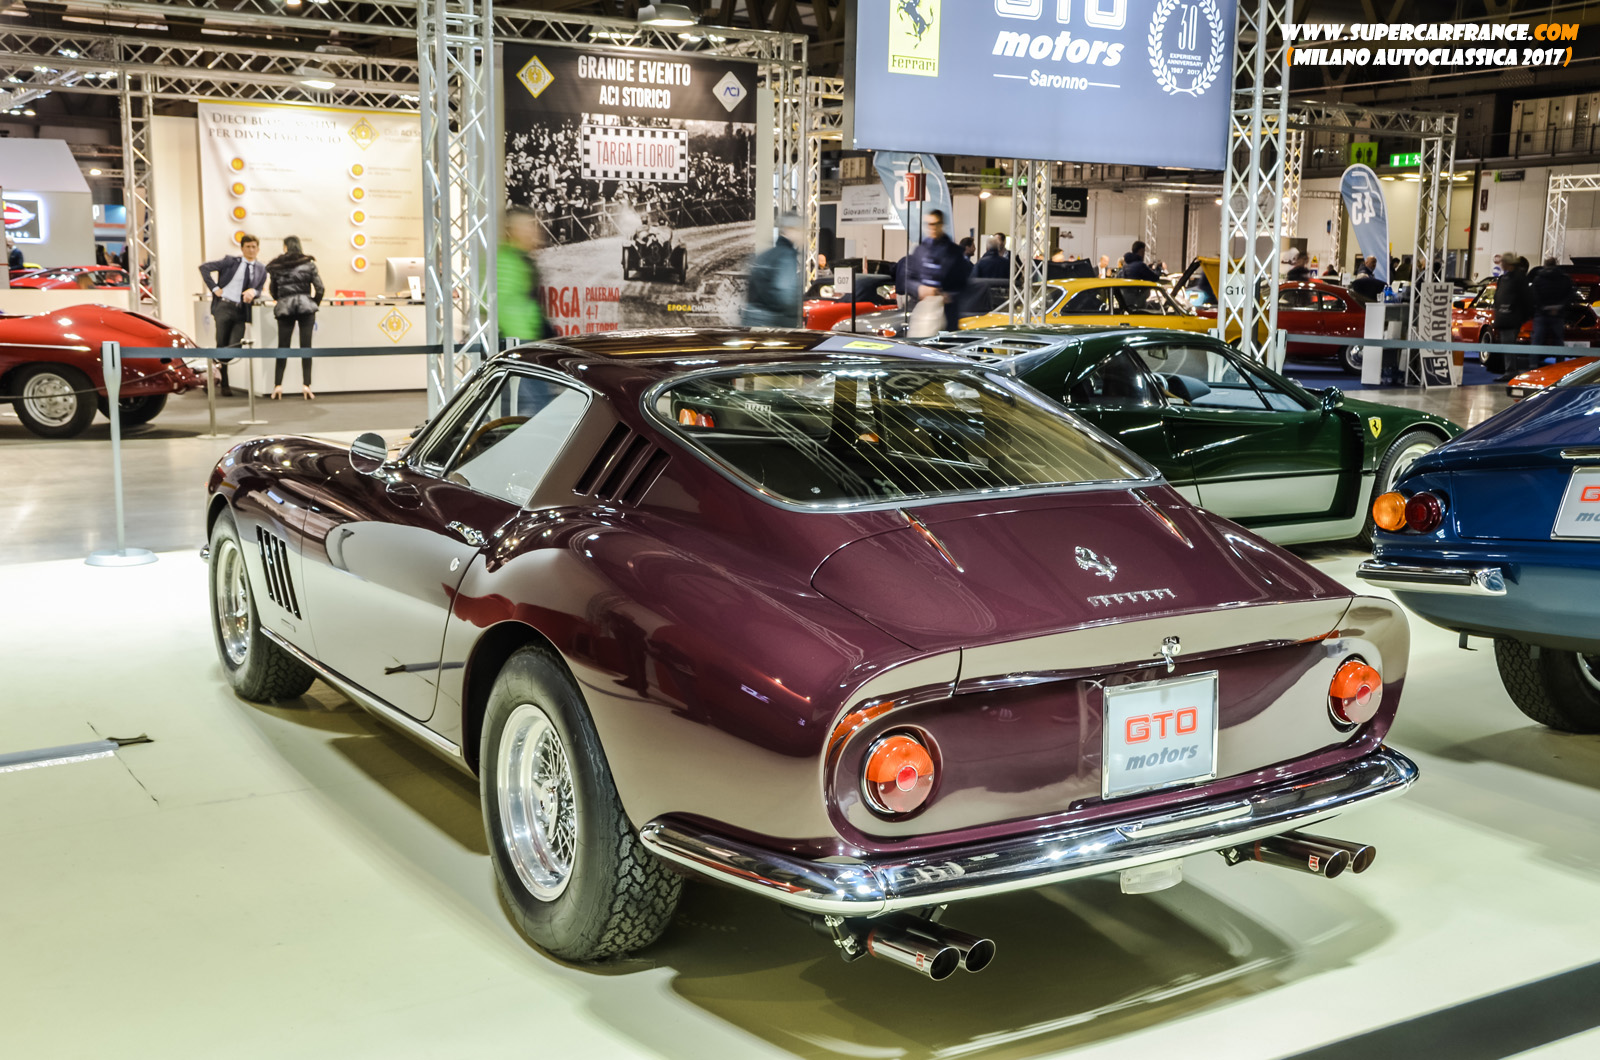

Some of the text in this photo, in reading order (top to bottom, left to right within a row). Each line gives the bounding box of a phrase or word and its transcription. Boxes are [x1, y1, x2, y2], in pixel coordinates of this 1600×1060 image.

[1178, 4, 1198, 51] 30
[992, 30, 1125, 67] motors
[1170, 52, 1202, 61] EXPERIENCE
[577, 55, 691, 87] GRANDE EVENTO
[891, 54, 936, 71] Ferrari
[1167, 58, 1204, 67] ANNIVERSARY
[1170, 66, 1184, 74] 1987
[1029, 69, 1089, 91] Saronno
[599, 84, 671, 110] ACI STORICO
[209, 127, 230, 138] PER
[596, 140, 675, 169] TARGA FLORIO
[843, 206, 872, 216] Giovanni
[837, 277, 850, 285] G07
[539, 286, 580, 318] ARGA
[585, 287, 620, 302] PALERMO
[585, 304, 598, 320] 4-7
[1433, 357, 1449, 379] 45
[1124, 706, 1198, 746] GTO
[1125, 744, 1199, 771] motors
